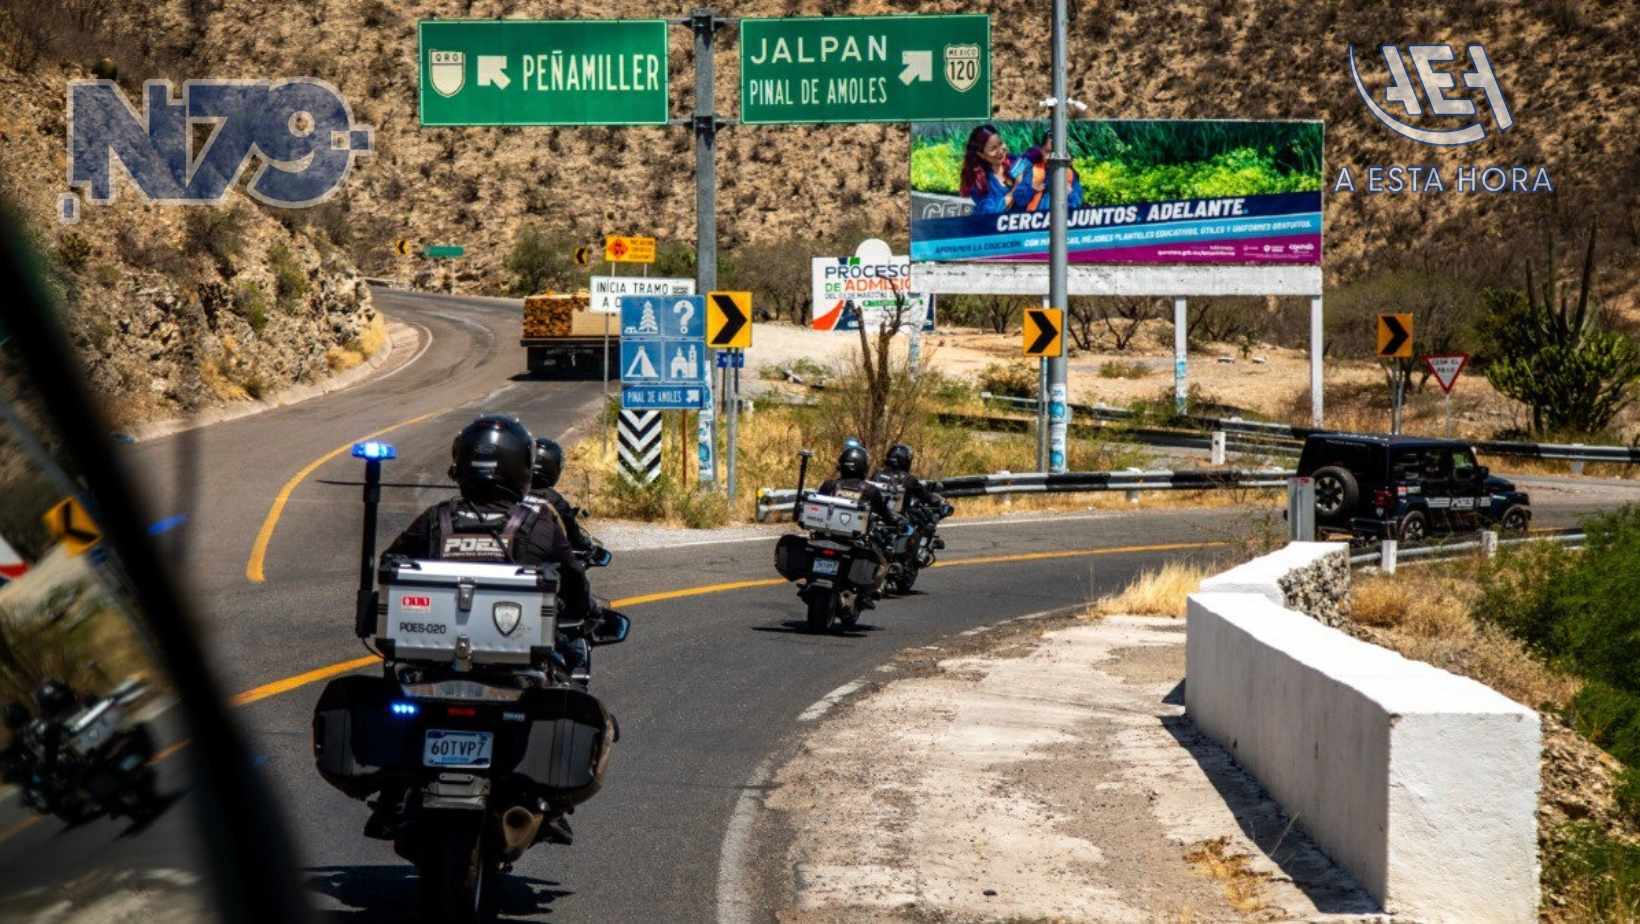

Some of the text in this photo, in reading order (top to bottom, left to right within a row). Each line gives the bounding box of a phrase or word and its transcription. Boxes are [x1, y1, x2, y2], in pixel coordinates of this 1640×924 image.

[751, 35, 888, 64] JALPAN
[522, 50, 659, 91] PEÑAMILLER
[950, 60, 976, 81] 120
[750, 77, 887, 105] PINAL DE AMOLES
[634, 283, 669, 295] TRAMO
[825, 283, 841, 292] DE
[602, 297, 610, 308] A
[400, 622, 447, 635] POES-020
[432, 740, 487, 756] 60TVP7
